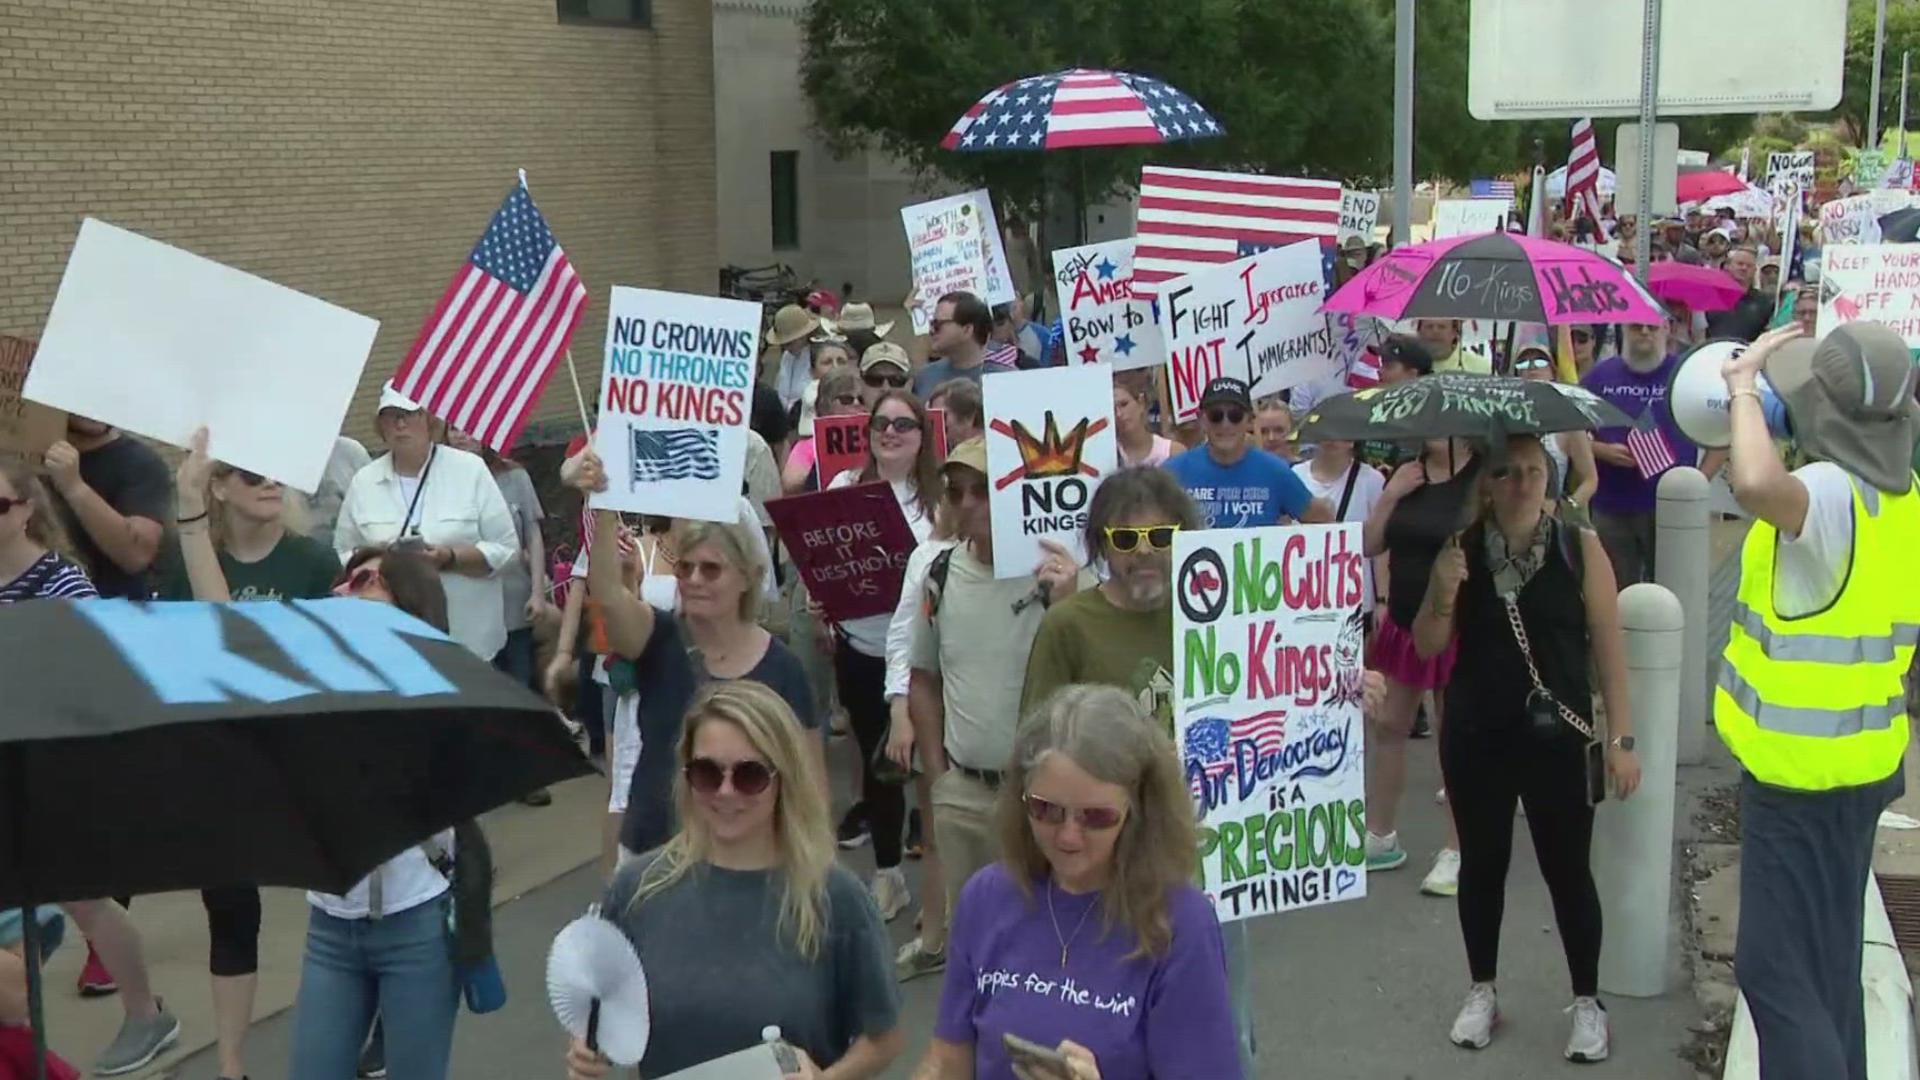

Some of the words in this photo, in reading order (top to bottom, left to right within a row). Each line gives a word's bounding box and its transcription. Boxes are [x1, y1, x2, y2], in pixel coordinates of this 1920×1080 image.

[1058, 252, 1098, 287] REAL
[1828, 251, 1870, 272] KEEP
[1881, 252, 1920, 268] YOUR
[1239, 262, 1319, 325] Ignorance
[1475, 263, 1534, 314] Kings
[1541, 265, 1630, 315] Hate
[1855, 292, 1893, 310] OFF
[613, 316, 646, 348] NO
[652, 320, 753, 359] CROWNS
[610, 346, 642, 377] NO
[649, 350, 750, 389] THRONES
[1171, 338, 1226, 410] NOT
[606, 377, 648, 416] NO
[655, 383, 744, 427] KINGS
[1022, 478, 1088, 516] NO
[1232, 501, 1264, 516] VOTE
[803, 521, 881, 548] BEFORE
[1023, 511, 1088, 536] KINGS
[812, 551, 908, 583] DESTROYS
[836, 545, 854, 561] IT
[1233, 538, 1283, 616] No
[1283, 530, 1362, 611] Cults
[848, 578, 880, 596] US
[1183, 625, 1241, 700] No
[1247, 620, 1332, 707] Kings
[1235, 716, 1351, 802] Democracy
[1197, 798, 1366, 891] PRECIOUS
[1023, 973, 1057, 996] for
[1060, 977, 1090, 1005] the
